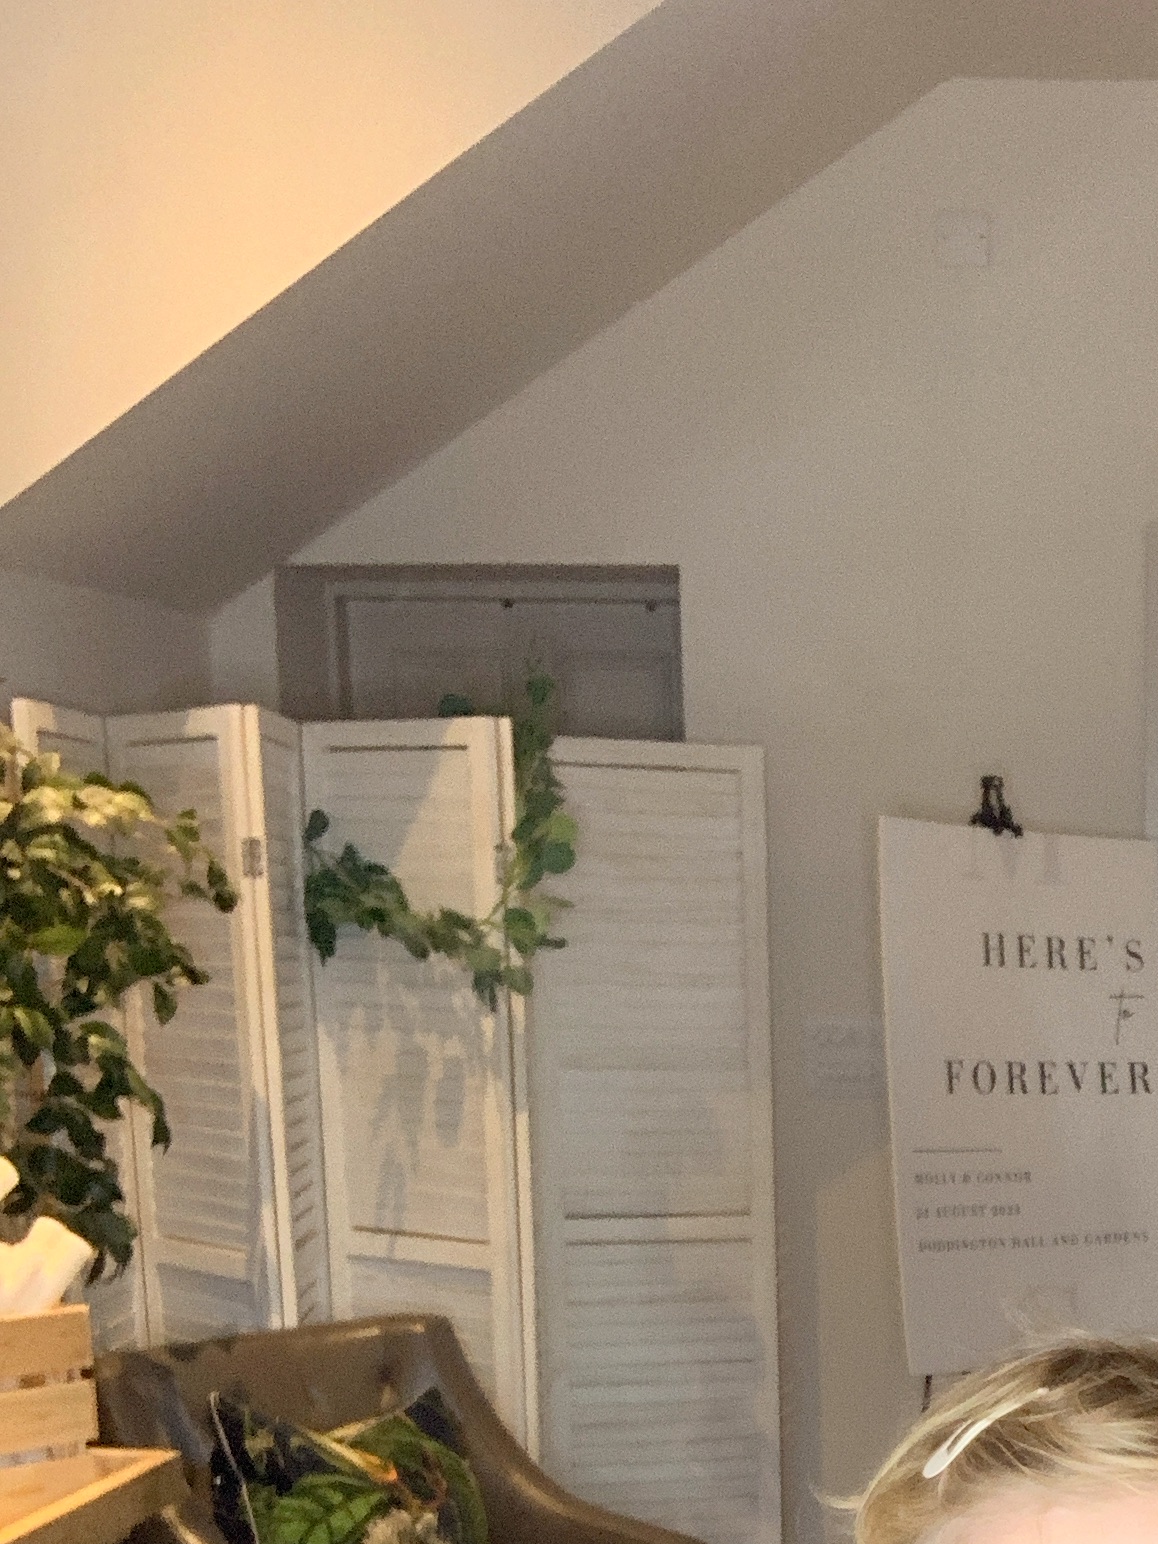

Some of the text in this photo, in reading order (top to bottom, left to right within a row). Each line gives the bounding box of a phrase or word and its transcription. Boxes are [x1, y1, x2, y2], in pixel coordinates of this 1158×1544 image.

[981, 931, 1145, 973] HERE'S
[943, 1059, 1153, 1096] FOREVER
[935, 1203, 988, 1219] AUGUST
[1010, 1235, 1046, 1250] HALL
[1051, 1233, 1080, 1248] AND
[1083, 1230, 1150, 1247] GARDENS
